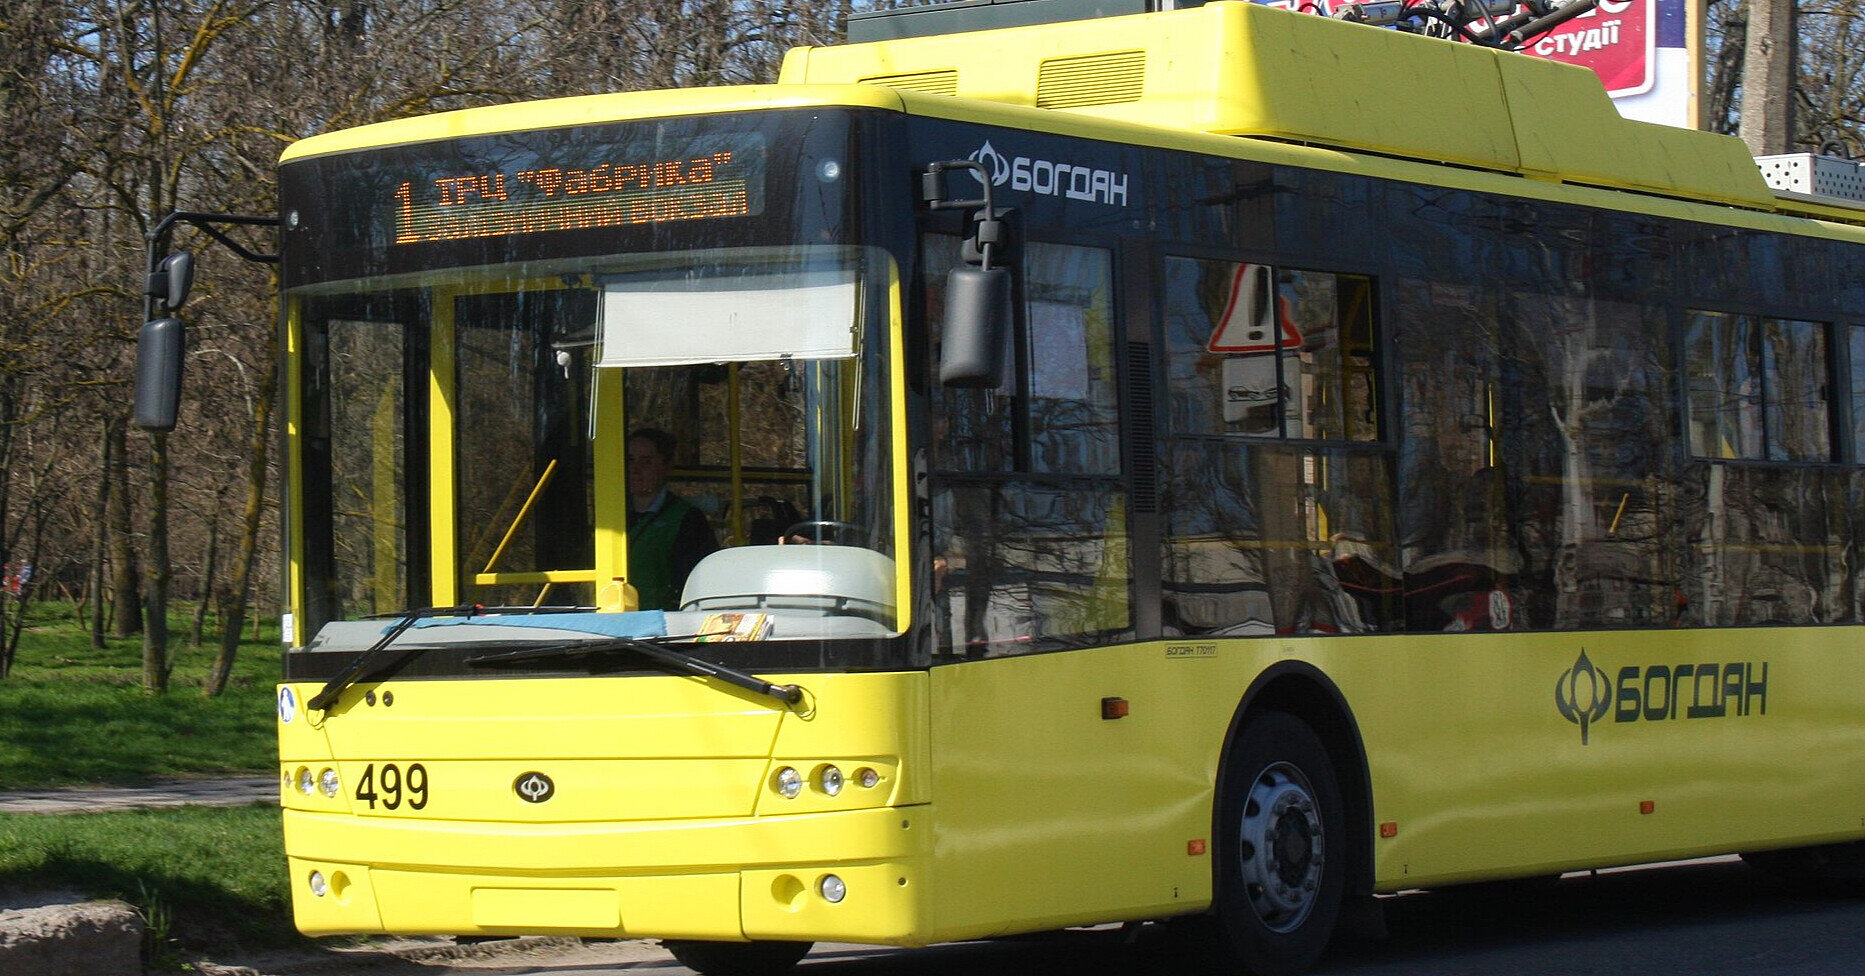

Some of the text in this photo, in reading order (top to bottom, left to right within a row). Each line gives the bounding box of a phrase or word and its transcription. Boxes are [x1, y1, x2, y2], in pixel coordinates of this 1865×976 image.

[1534, 19, 1622, 56] студії
[434, 171, 509, 206] ТРЦ
[1011, 156, 1128, 207] БОГДАН
[394, 182, 421, 244] 1
[1614, 661, 1769, 723] БОГДАН
[355, 762, 429, 811] 499
